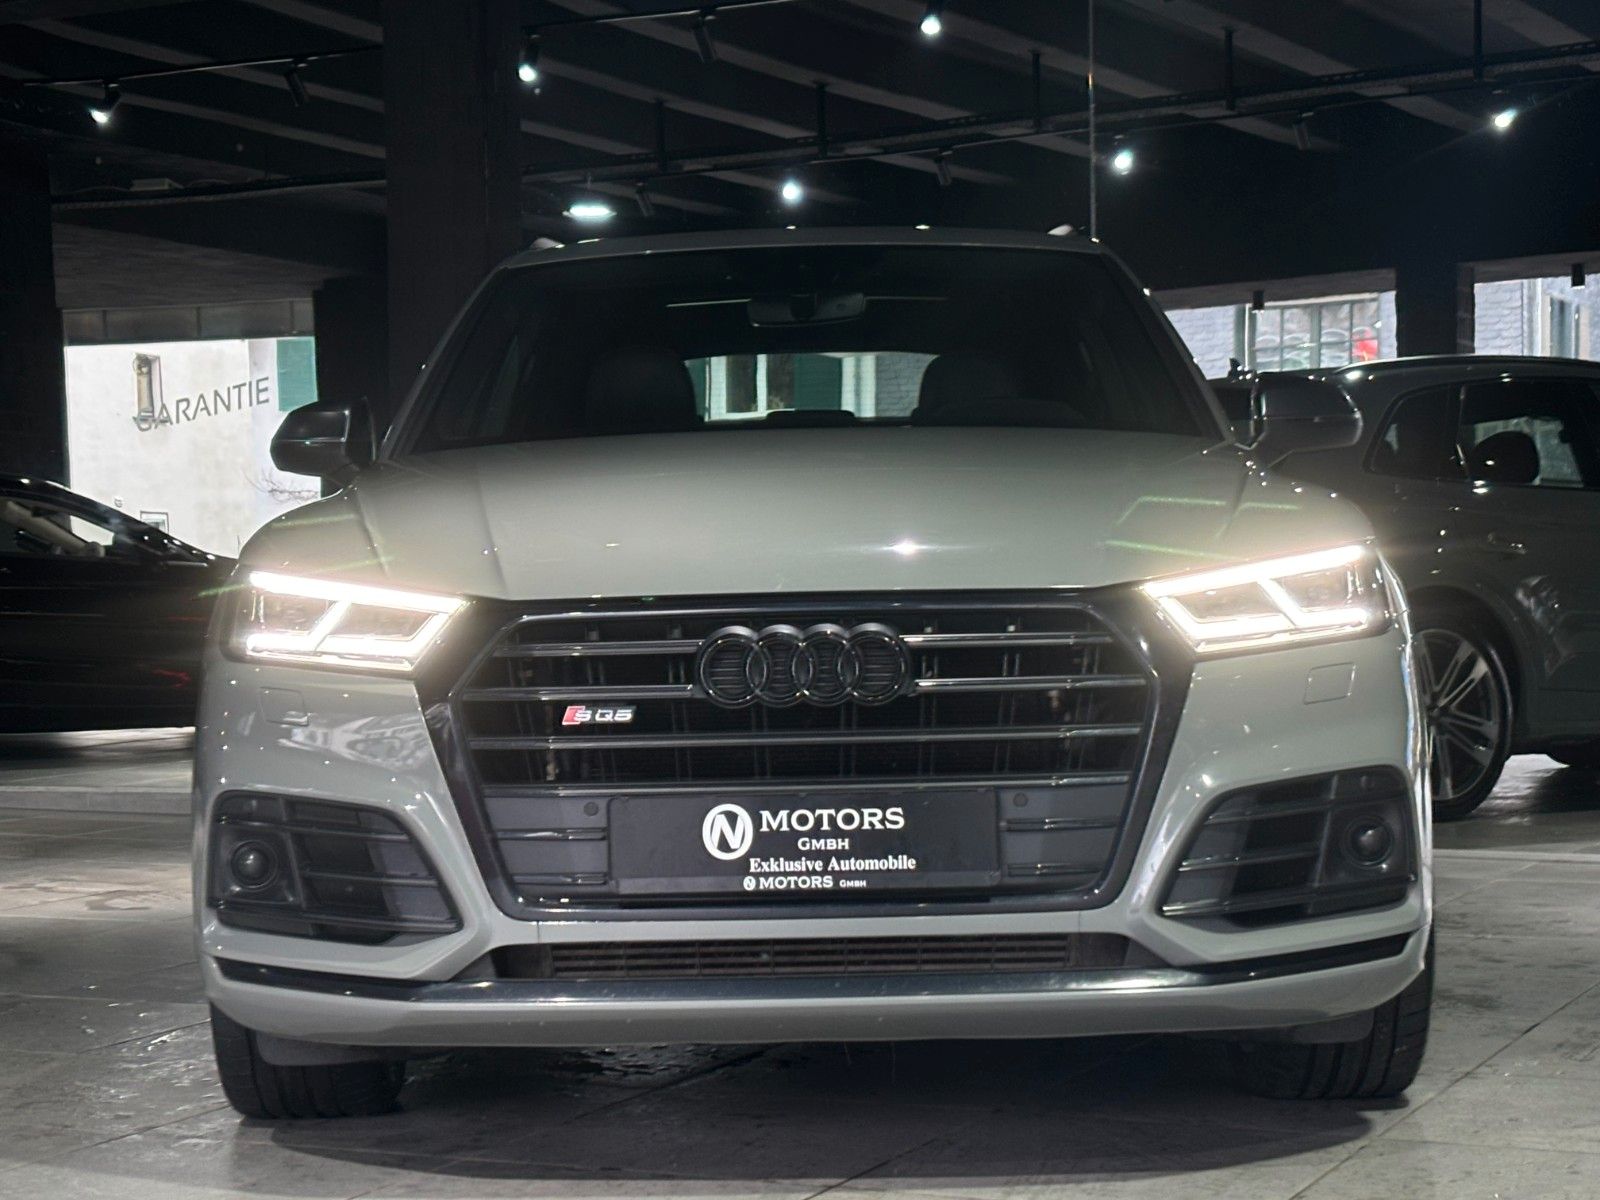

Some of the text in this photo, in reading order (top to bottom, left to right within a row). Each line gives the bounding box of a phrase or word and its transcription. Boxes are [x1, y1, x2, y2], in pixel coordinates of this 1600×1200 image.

[133, 376, 270, 432] GARANTIE
[571, 707, 633, 722] SQ5
[759, 807, 905, 832] MOTORS
[797, 837, 850, 851] GMBH
[749, 855, 917, 872] Exklusive Automobile
[759, 876, 833, 889] MOTORS
